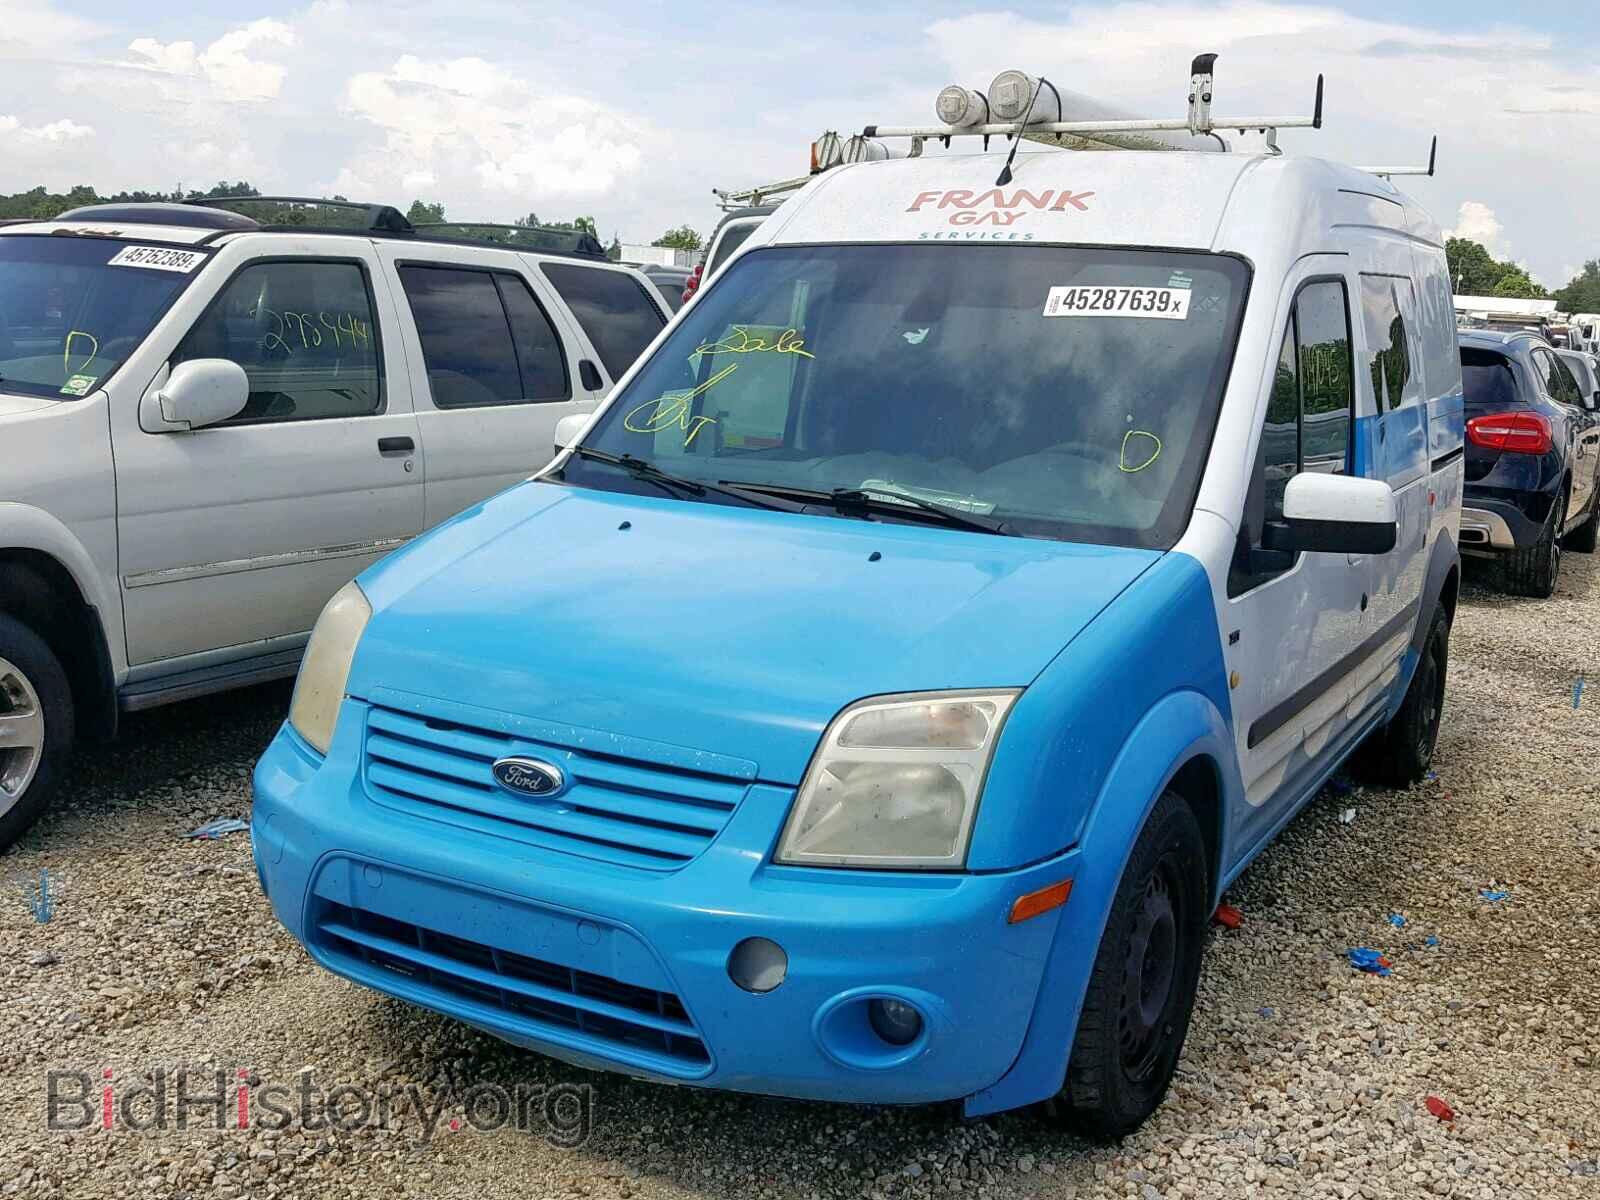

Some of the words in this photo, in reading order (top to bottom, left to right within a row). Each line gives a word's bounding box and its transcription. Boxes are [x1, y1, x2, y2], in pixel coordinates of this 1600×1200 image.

[905, 188, 1095, 212] FRANK
[948, 210, 1027, 226] GAY
[918, 231, 1034, 241] SERVICES
[504, 766, 542, 790] Ford
